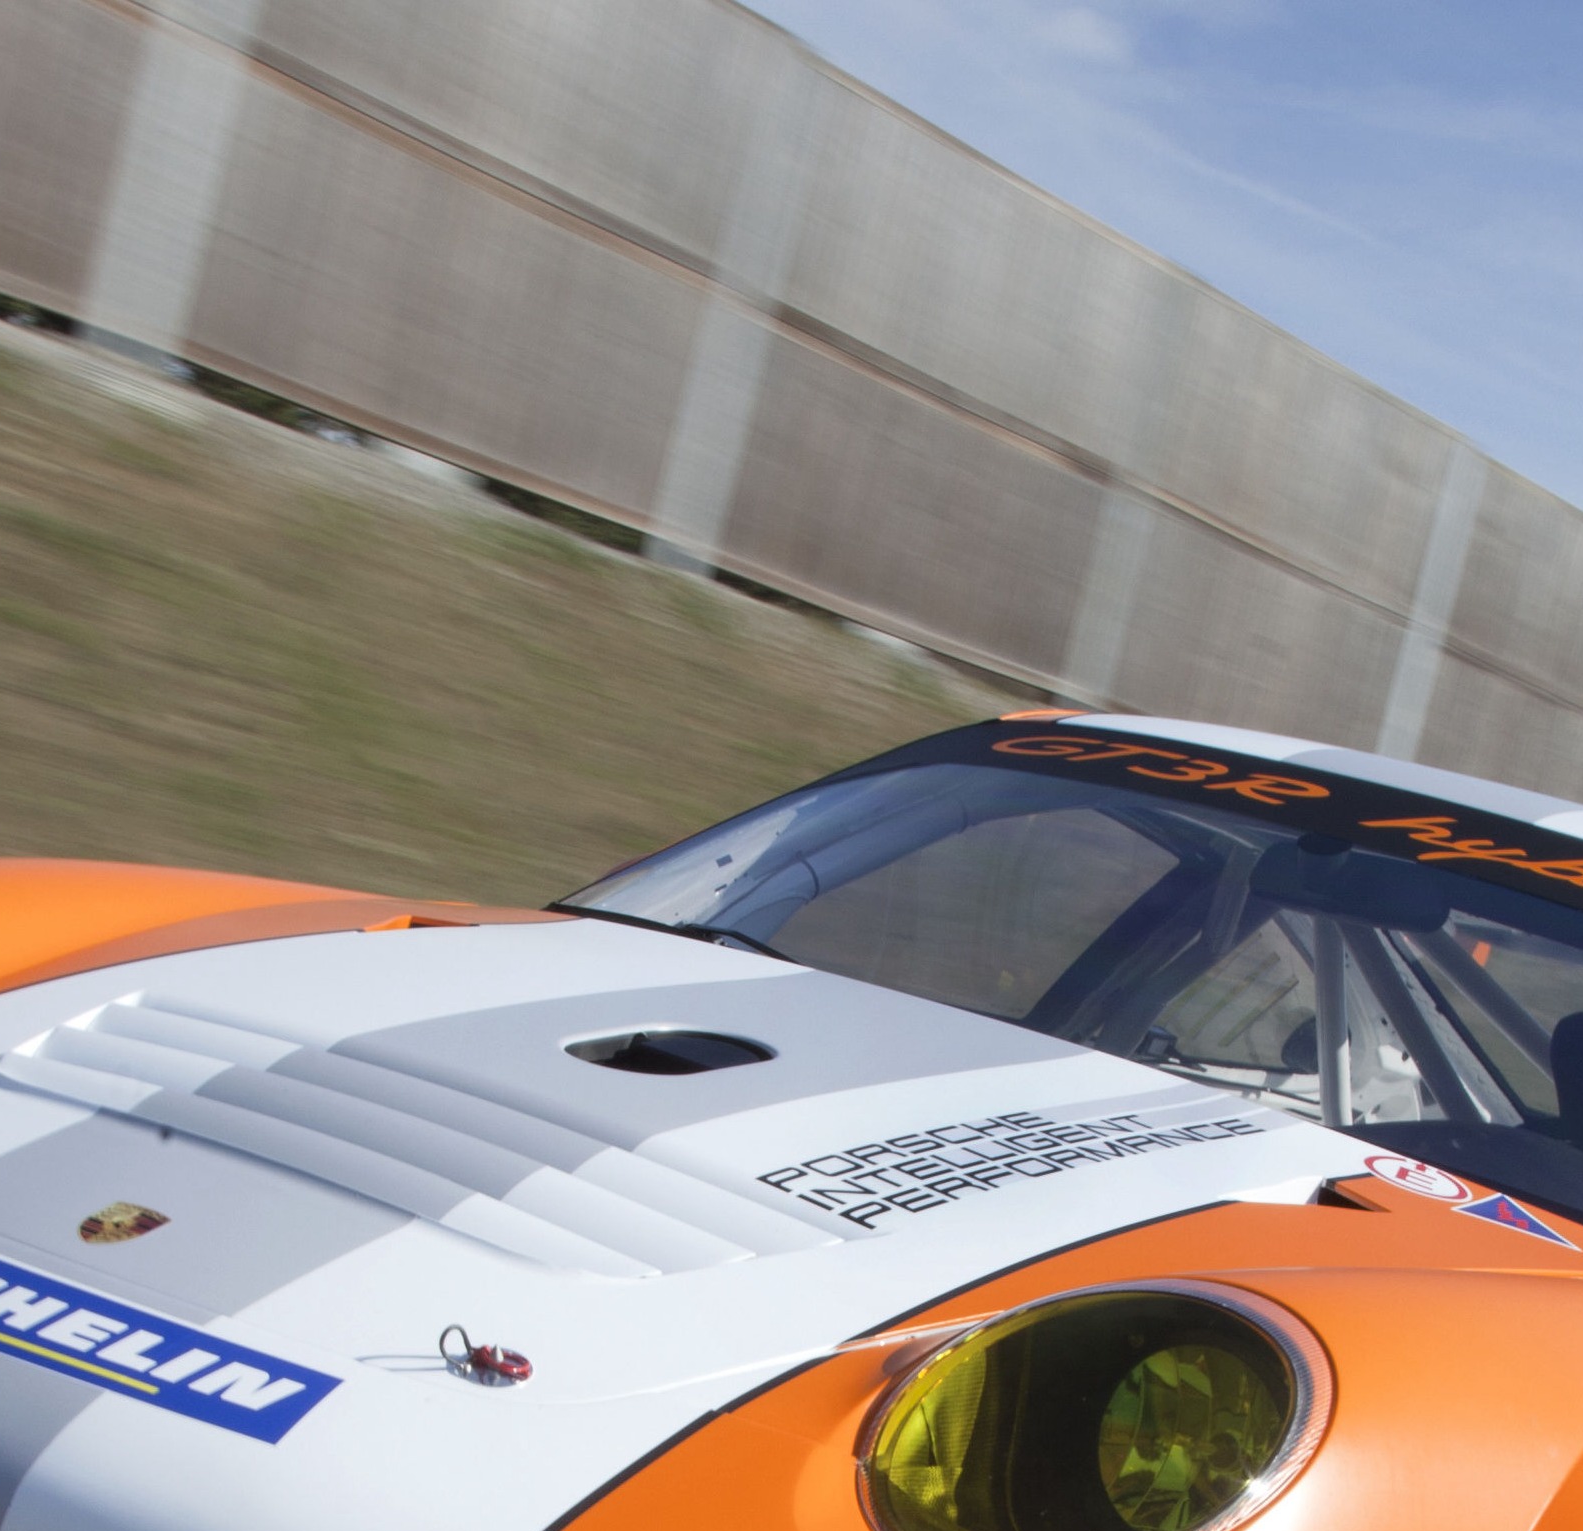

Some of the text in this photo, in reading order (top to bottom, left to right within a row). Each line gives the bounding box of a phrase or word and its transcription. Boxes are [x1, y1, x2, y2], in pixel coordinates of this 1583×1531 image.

[756, 1110, 1041, 1192] PORSCHE
[797, 1114, 1155, 1211] INTELLIGENT
[838, 1118, 1266, 1230] PERFORMANCE
